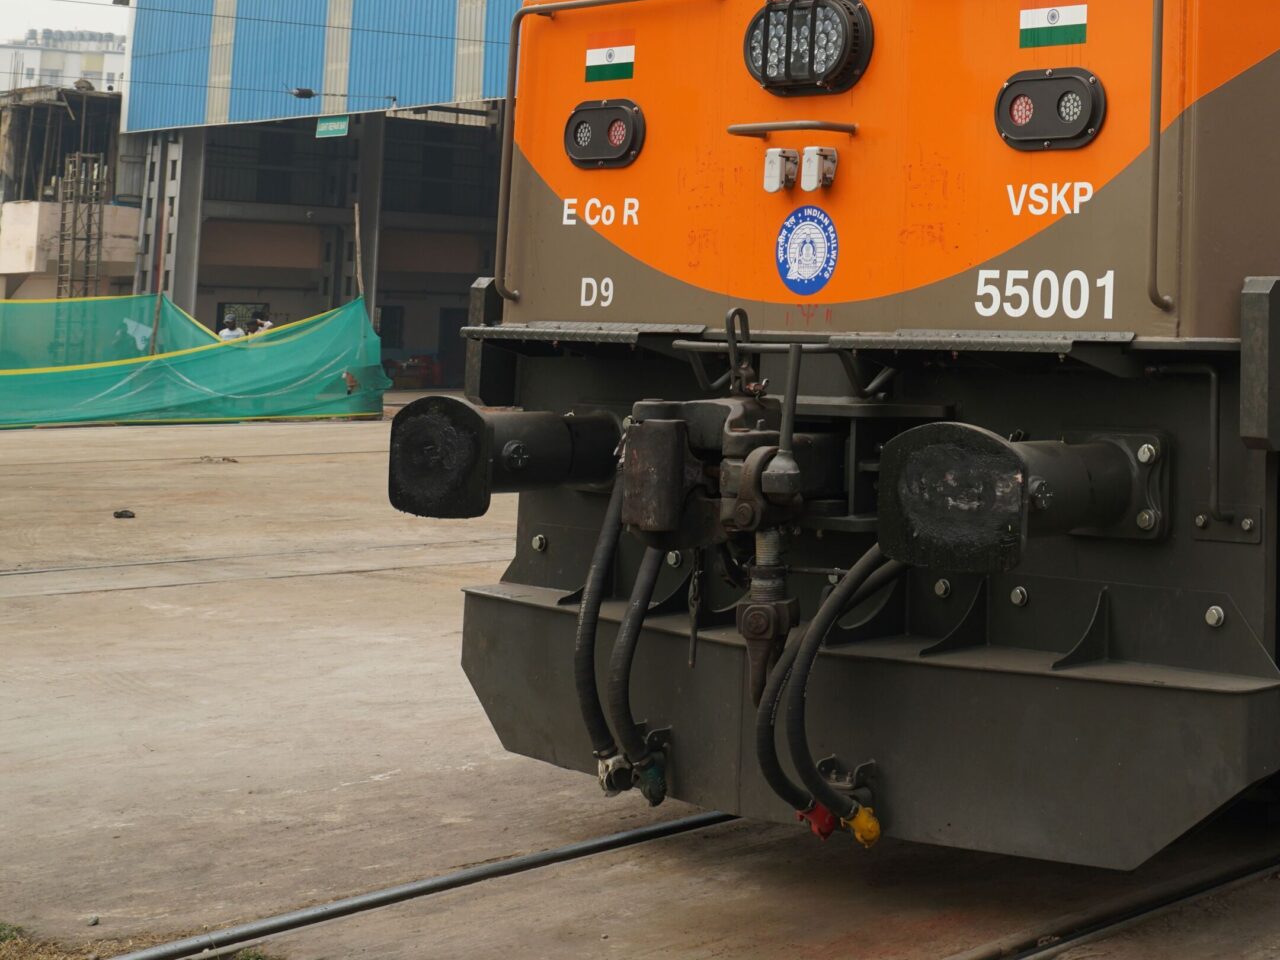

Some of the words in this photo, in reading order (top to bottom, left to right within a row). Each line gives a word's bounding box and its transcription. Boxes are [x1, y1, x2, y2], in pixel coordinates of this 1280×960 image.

[562, 198, 578, 226] E
[584, 197, 615, 226] Co
[623, 197, 640, 225] R
[1006, 181, 1095, 216] VSKP
[804, 207, 830, 226] INDIAN
[824, 225, 838, 279] RAILWAYS
[580, 276, 614, 308] D9
[974, 269, 1115, 320] 55001
